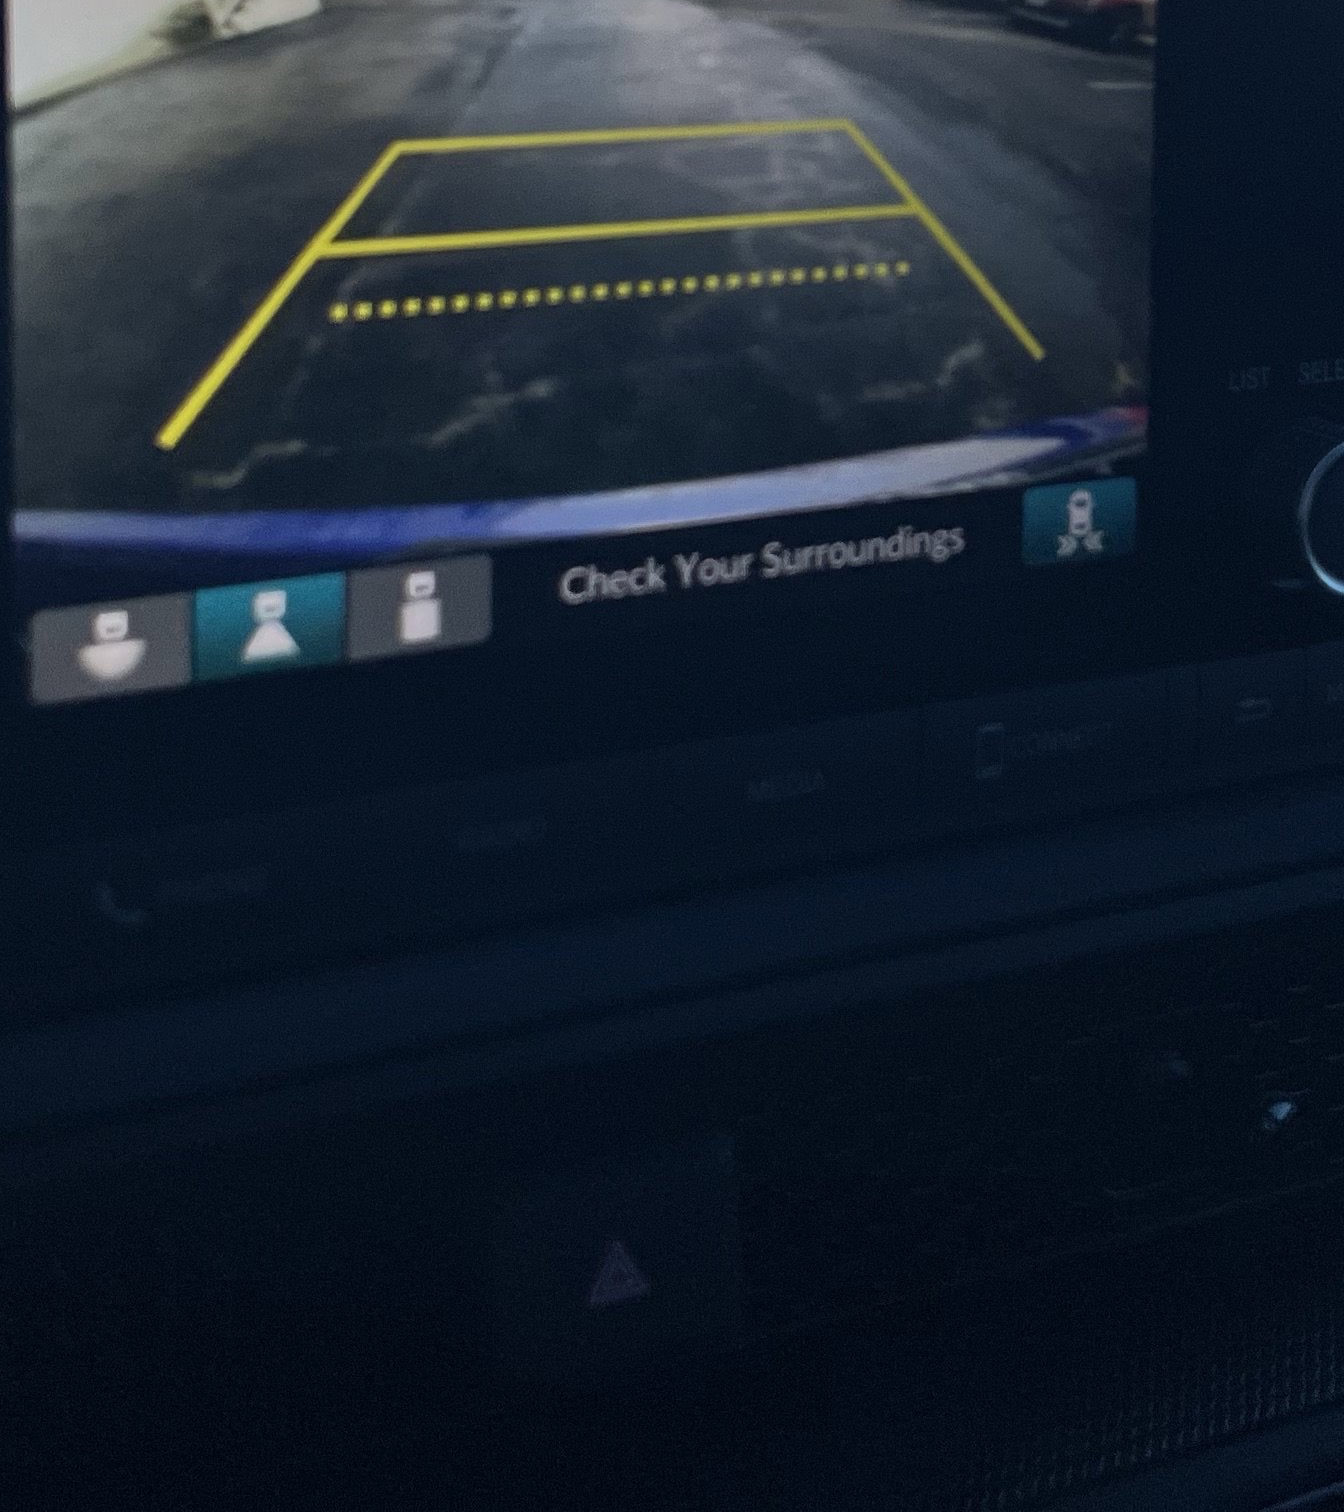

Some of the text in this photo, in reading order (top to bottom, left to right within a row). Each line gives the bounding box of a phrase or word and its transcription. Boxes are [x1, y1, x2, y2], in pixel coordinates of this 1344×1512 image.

[559, 525, 967, 606] Check Your Surroundings
